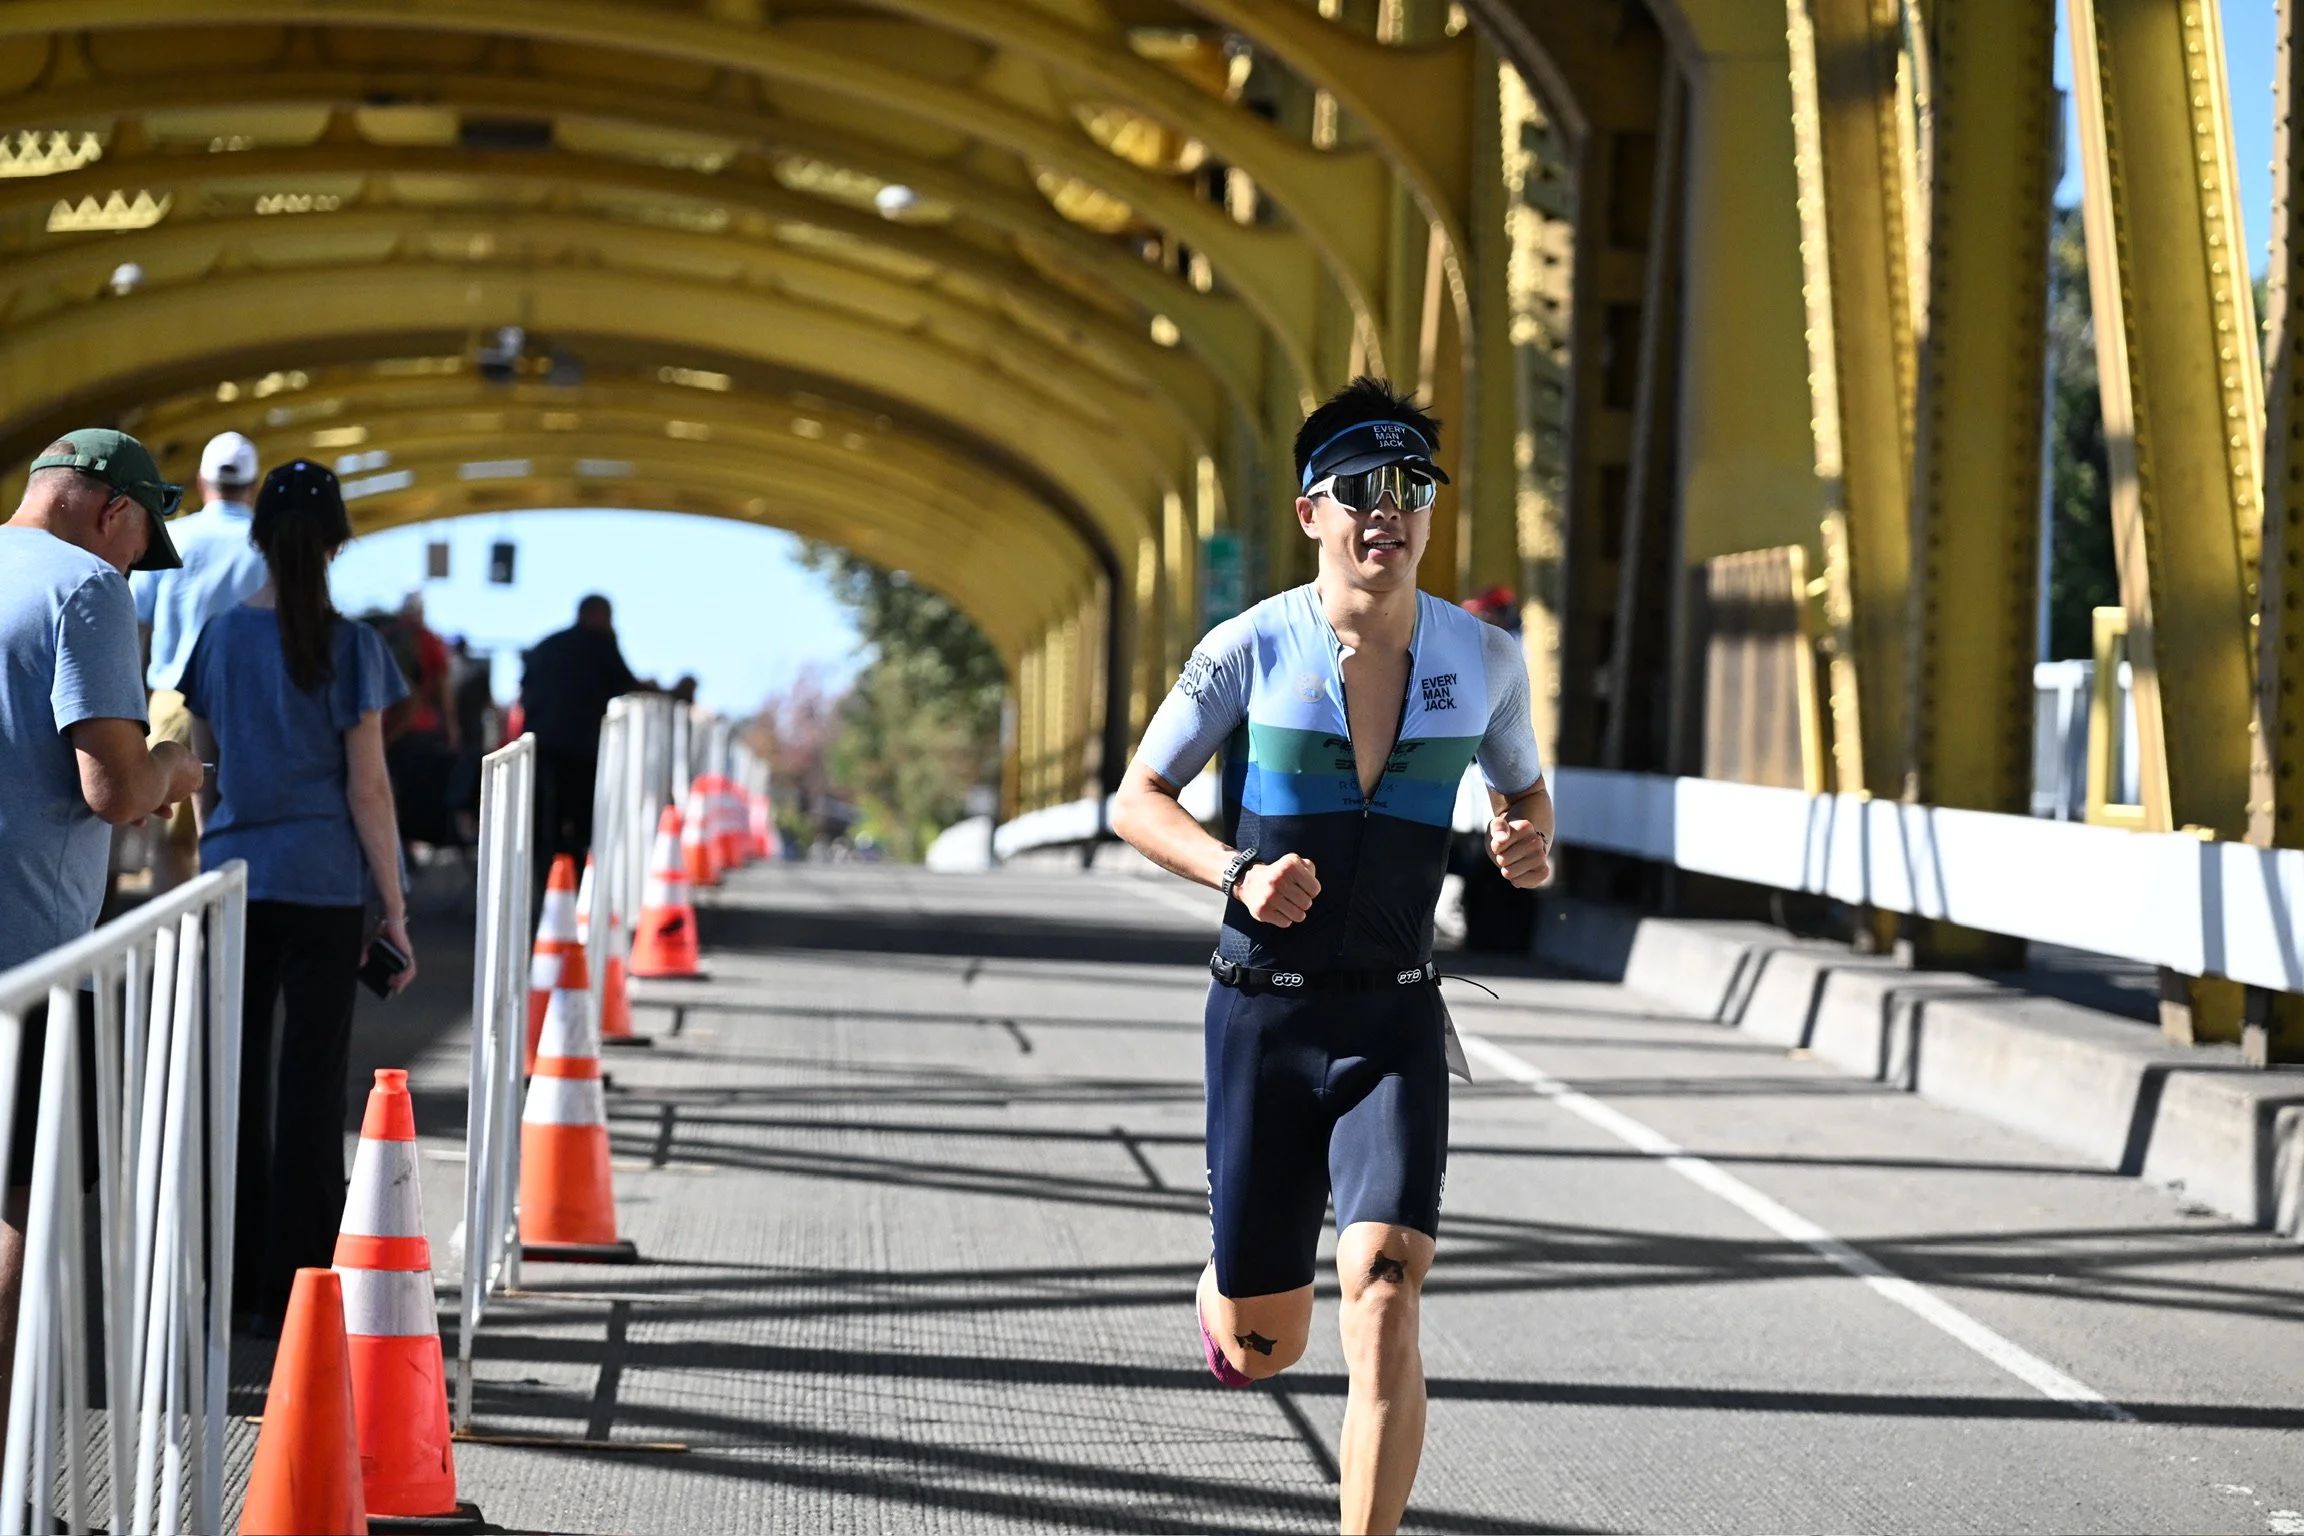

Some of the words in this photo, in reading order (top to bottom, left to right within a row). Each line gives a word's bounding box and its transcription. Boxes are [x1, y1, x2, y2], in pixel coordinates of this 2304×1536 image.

[1373, 425, 1406, 434] EVERY
[1375, 432, 1400, 440] MAN
[1421, 673, 1457, 690] EVERY
[1423, 686, 1450, 700] MAN
[1274, 975, 1301, 984] PTO
